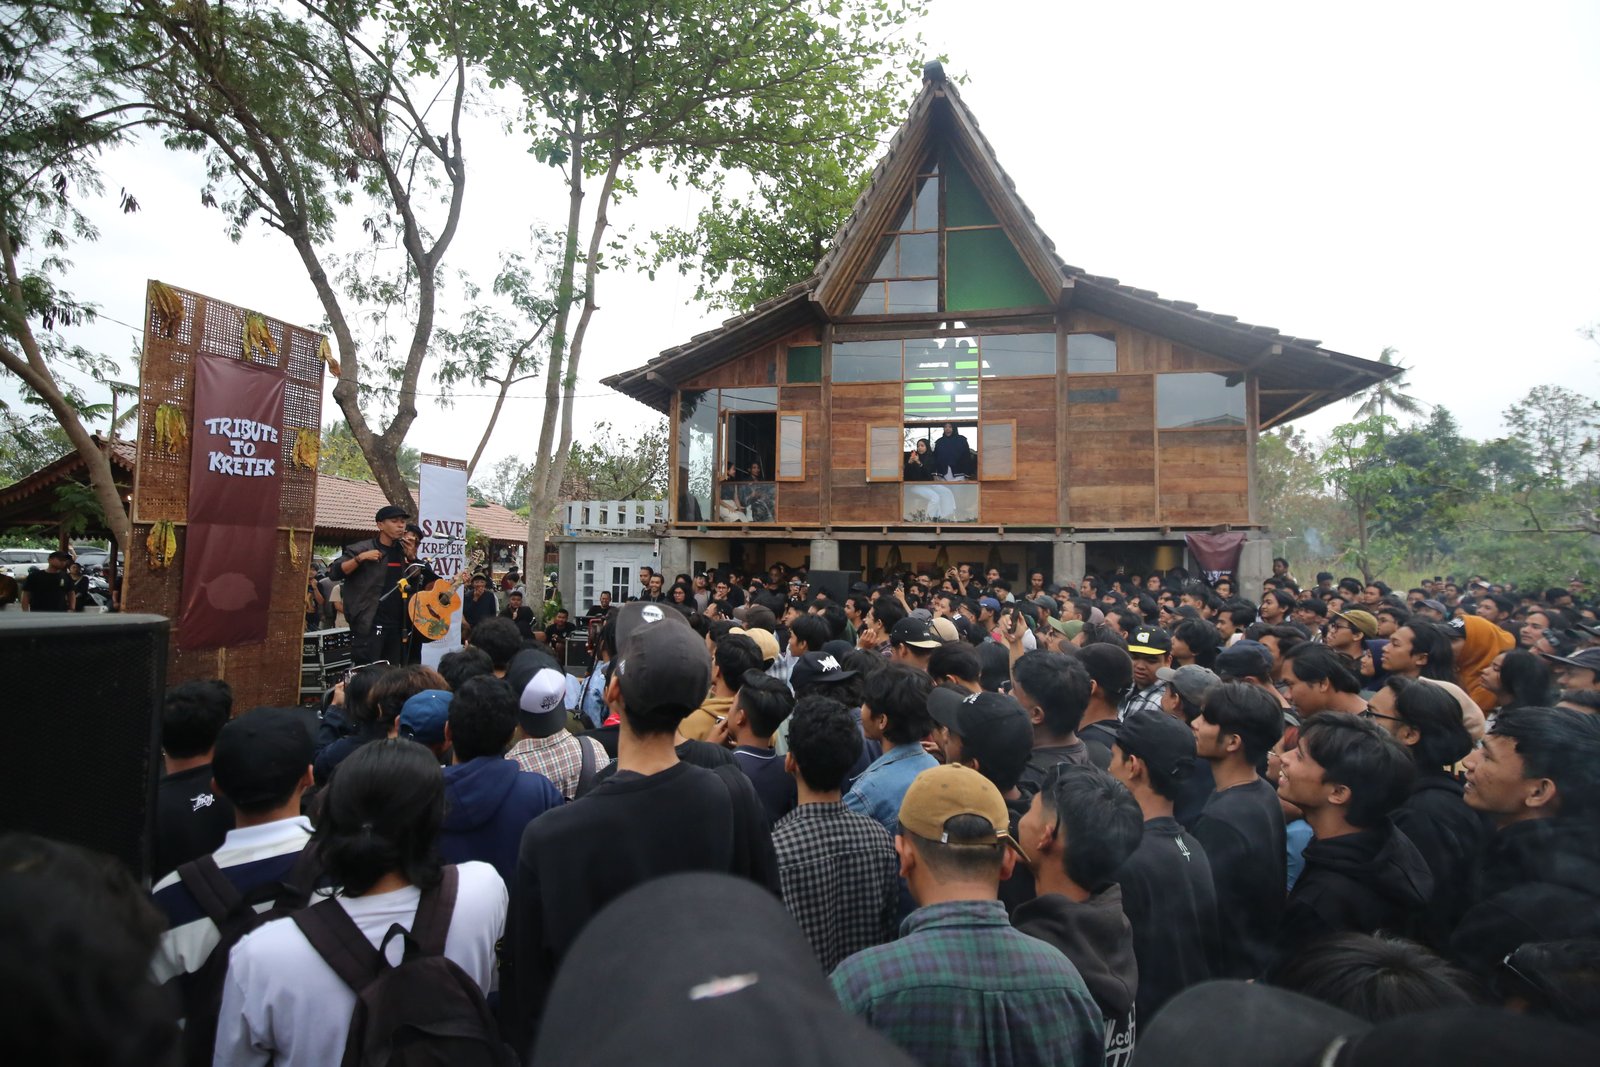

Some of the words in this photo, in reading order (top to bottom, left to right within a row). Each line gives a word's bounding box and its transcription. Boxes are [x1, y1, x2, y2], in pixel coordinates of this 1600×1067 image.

[204, 417, 278, 443] TRIBUTE
[230, 440, 256, 457] TO
[208, 451, 275, 476] KRETEK
[422, 519, 464, 538] SAVE
[421, 542, 463, 555] KRETEK
[422, 557, 463, 576] AVE
